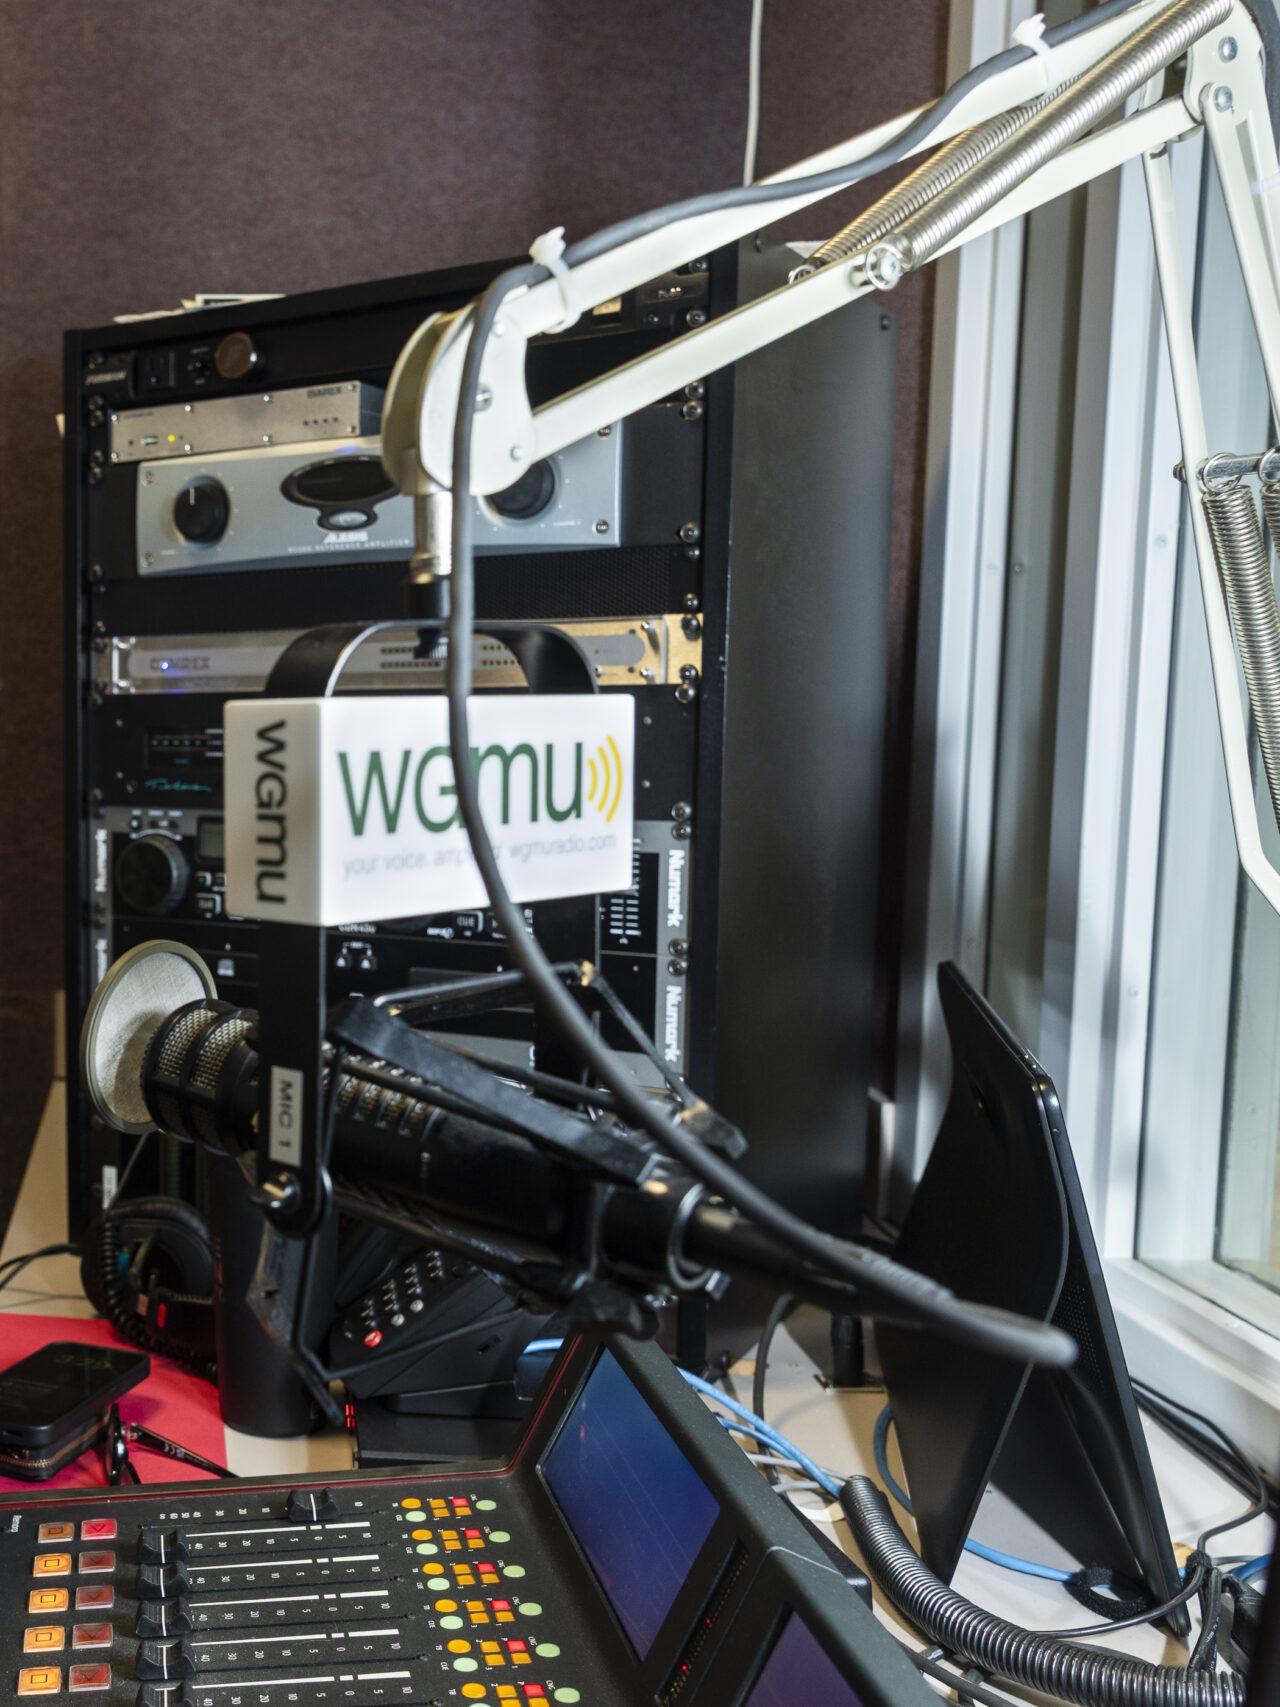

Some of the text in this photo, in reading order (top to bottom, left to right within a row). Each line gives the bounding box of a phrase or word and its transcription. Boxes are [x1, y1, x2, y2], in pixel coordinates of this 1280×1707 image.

[343, 854, 380, 881] your
[667, 849, 685, 928] Numark
[665, 985, 682, 1063] Numark
[279, 1081, 294, 1149] MIC 1
[416, 1582, 424, 1590] CUE
[250, 1610, 260, 1618] 20
[428, 1620, 436, 1629] CUE
[440, 1661, 449, 1671] CUE
[402, 1686, 412, 1694] 10
[231, 1696, 241, 1704] 30
[260, 1695, 269, 1703] 20
[288, 1693, 298, 1701] 10
[203, 1698, 213, 1706] 40
